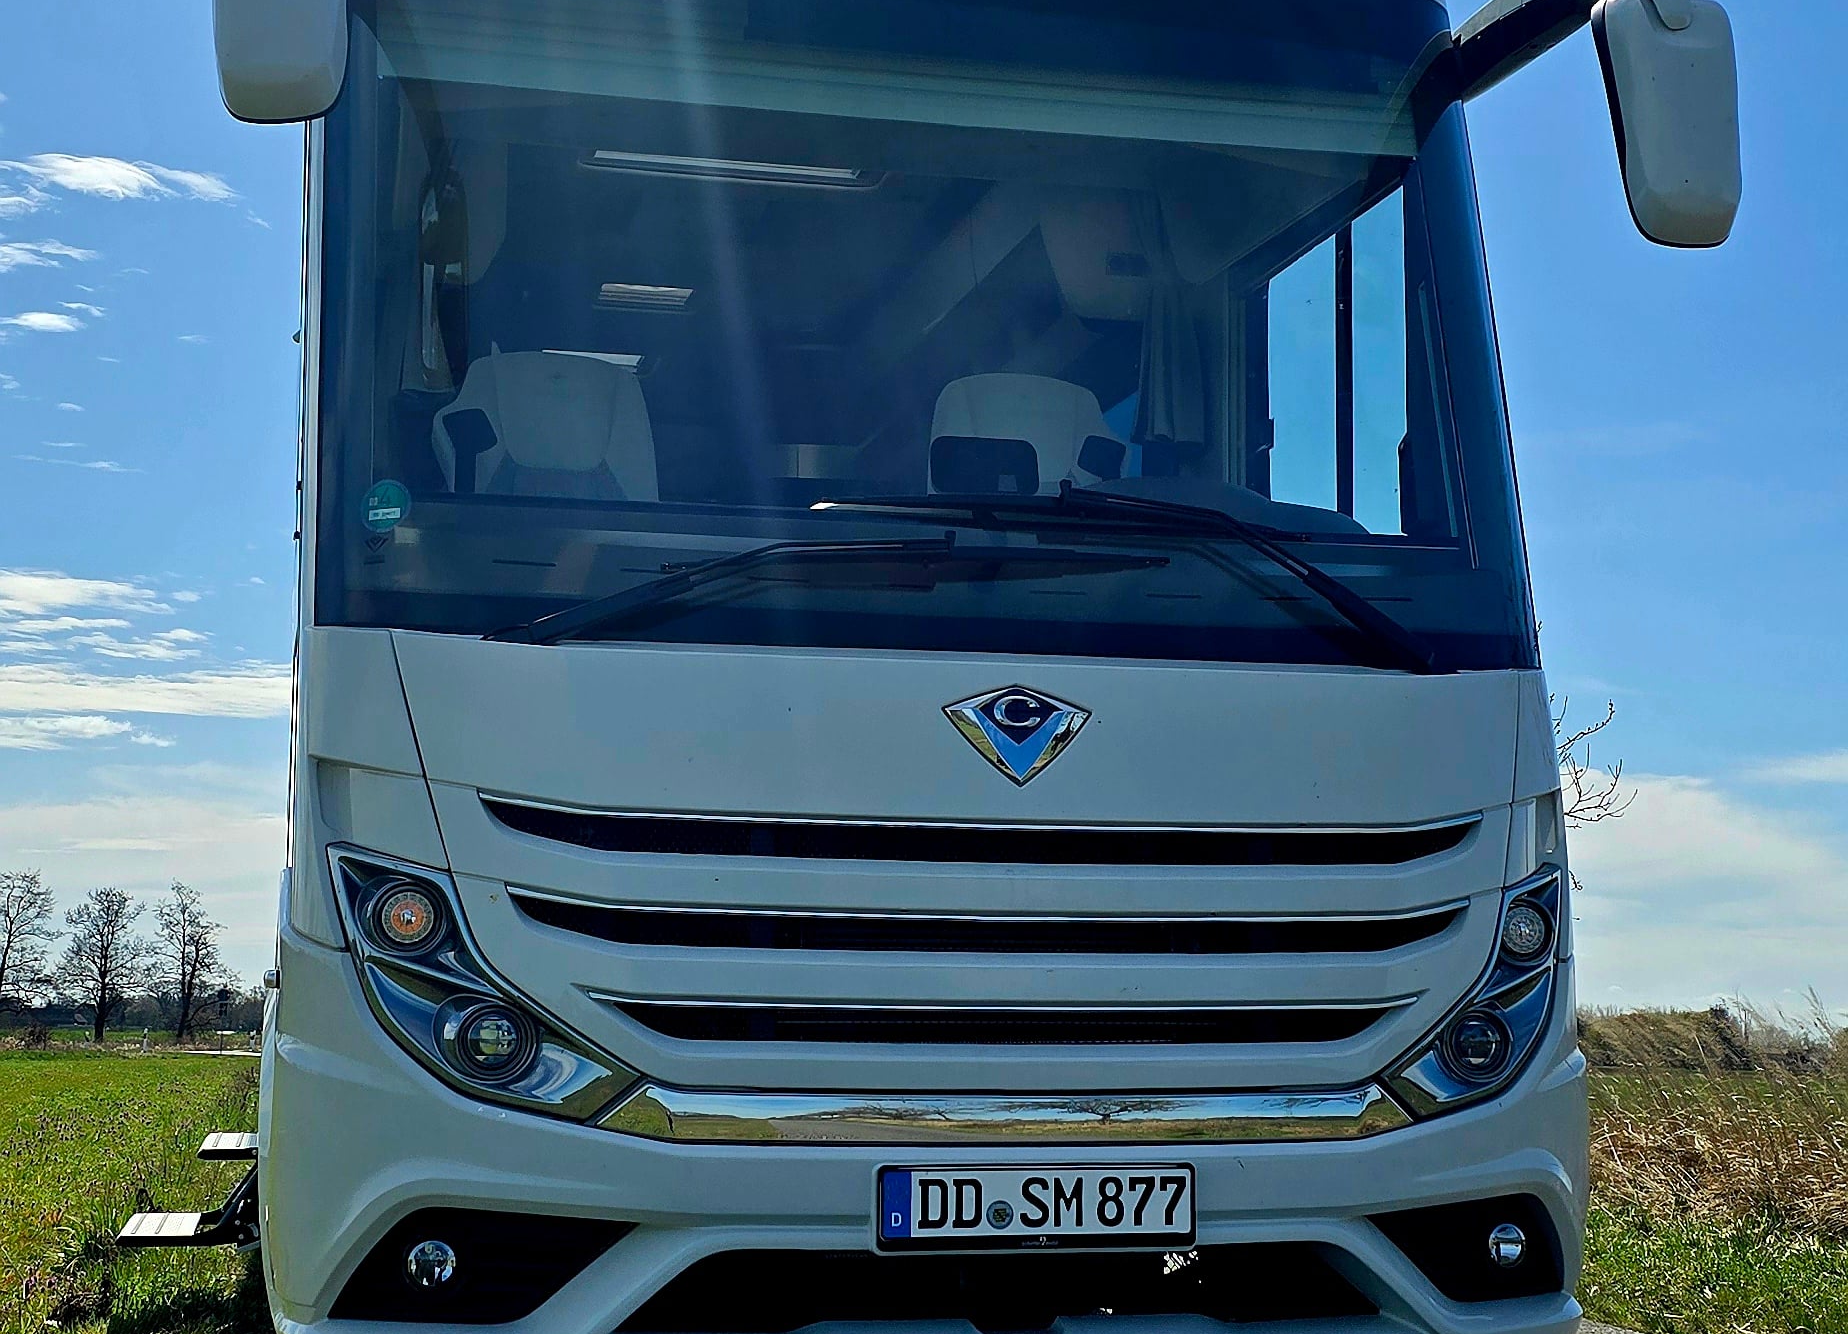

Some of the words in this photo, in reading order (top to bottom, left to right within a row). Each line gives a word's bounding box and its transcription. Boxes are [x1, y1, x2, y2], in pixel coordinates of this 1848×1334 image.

[891, 1212, 902, 1227] D
[917, 1177, 983, 1230] DD
[1019, 1175, 1084, 1228] SM
[1097, 1175, 1187, 1227] 877
